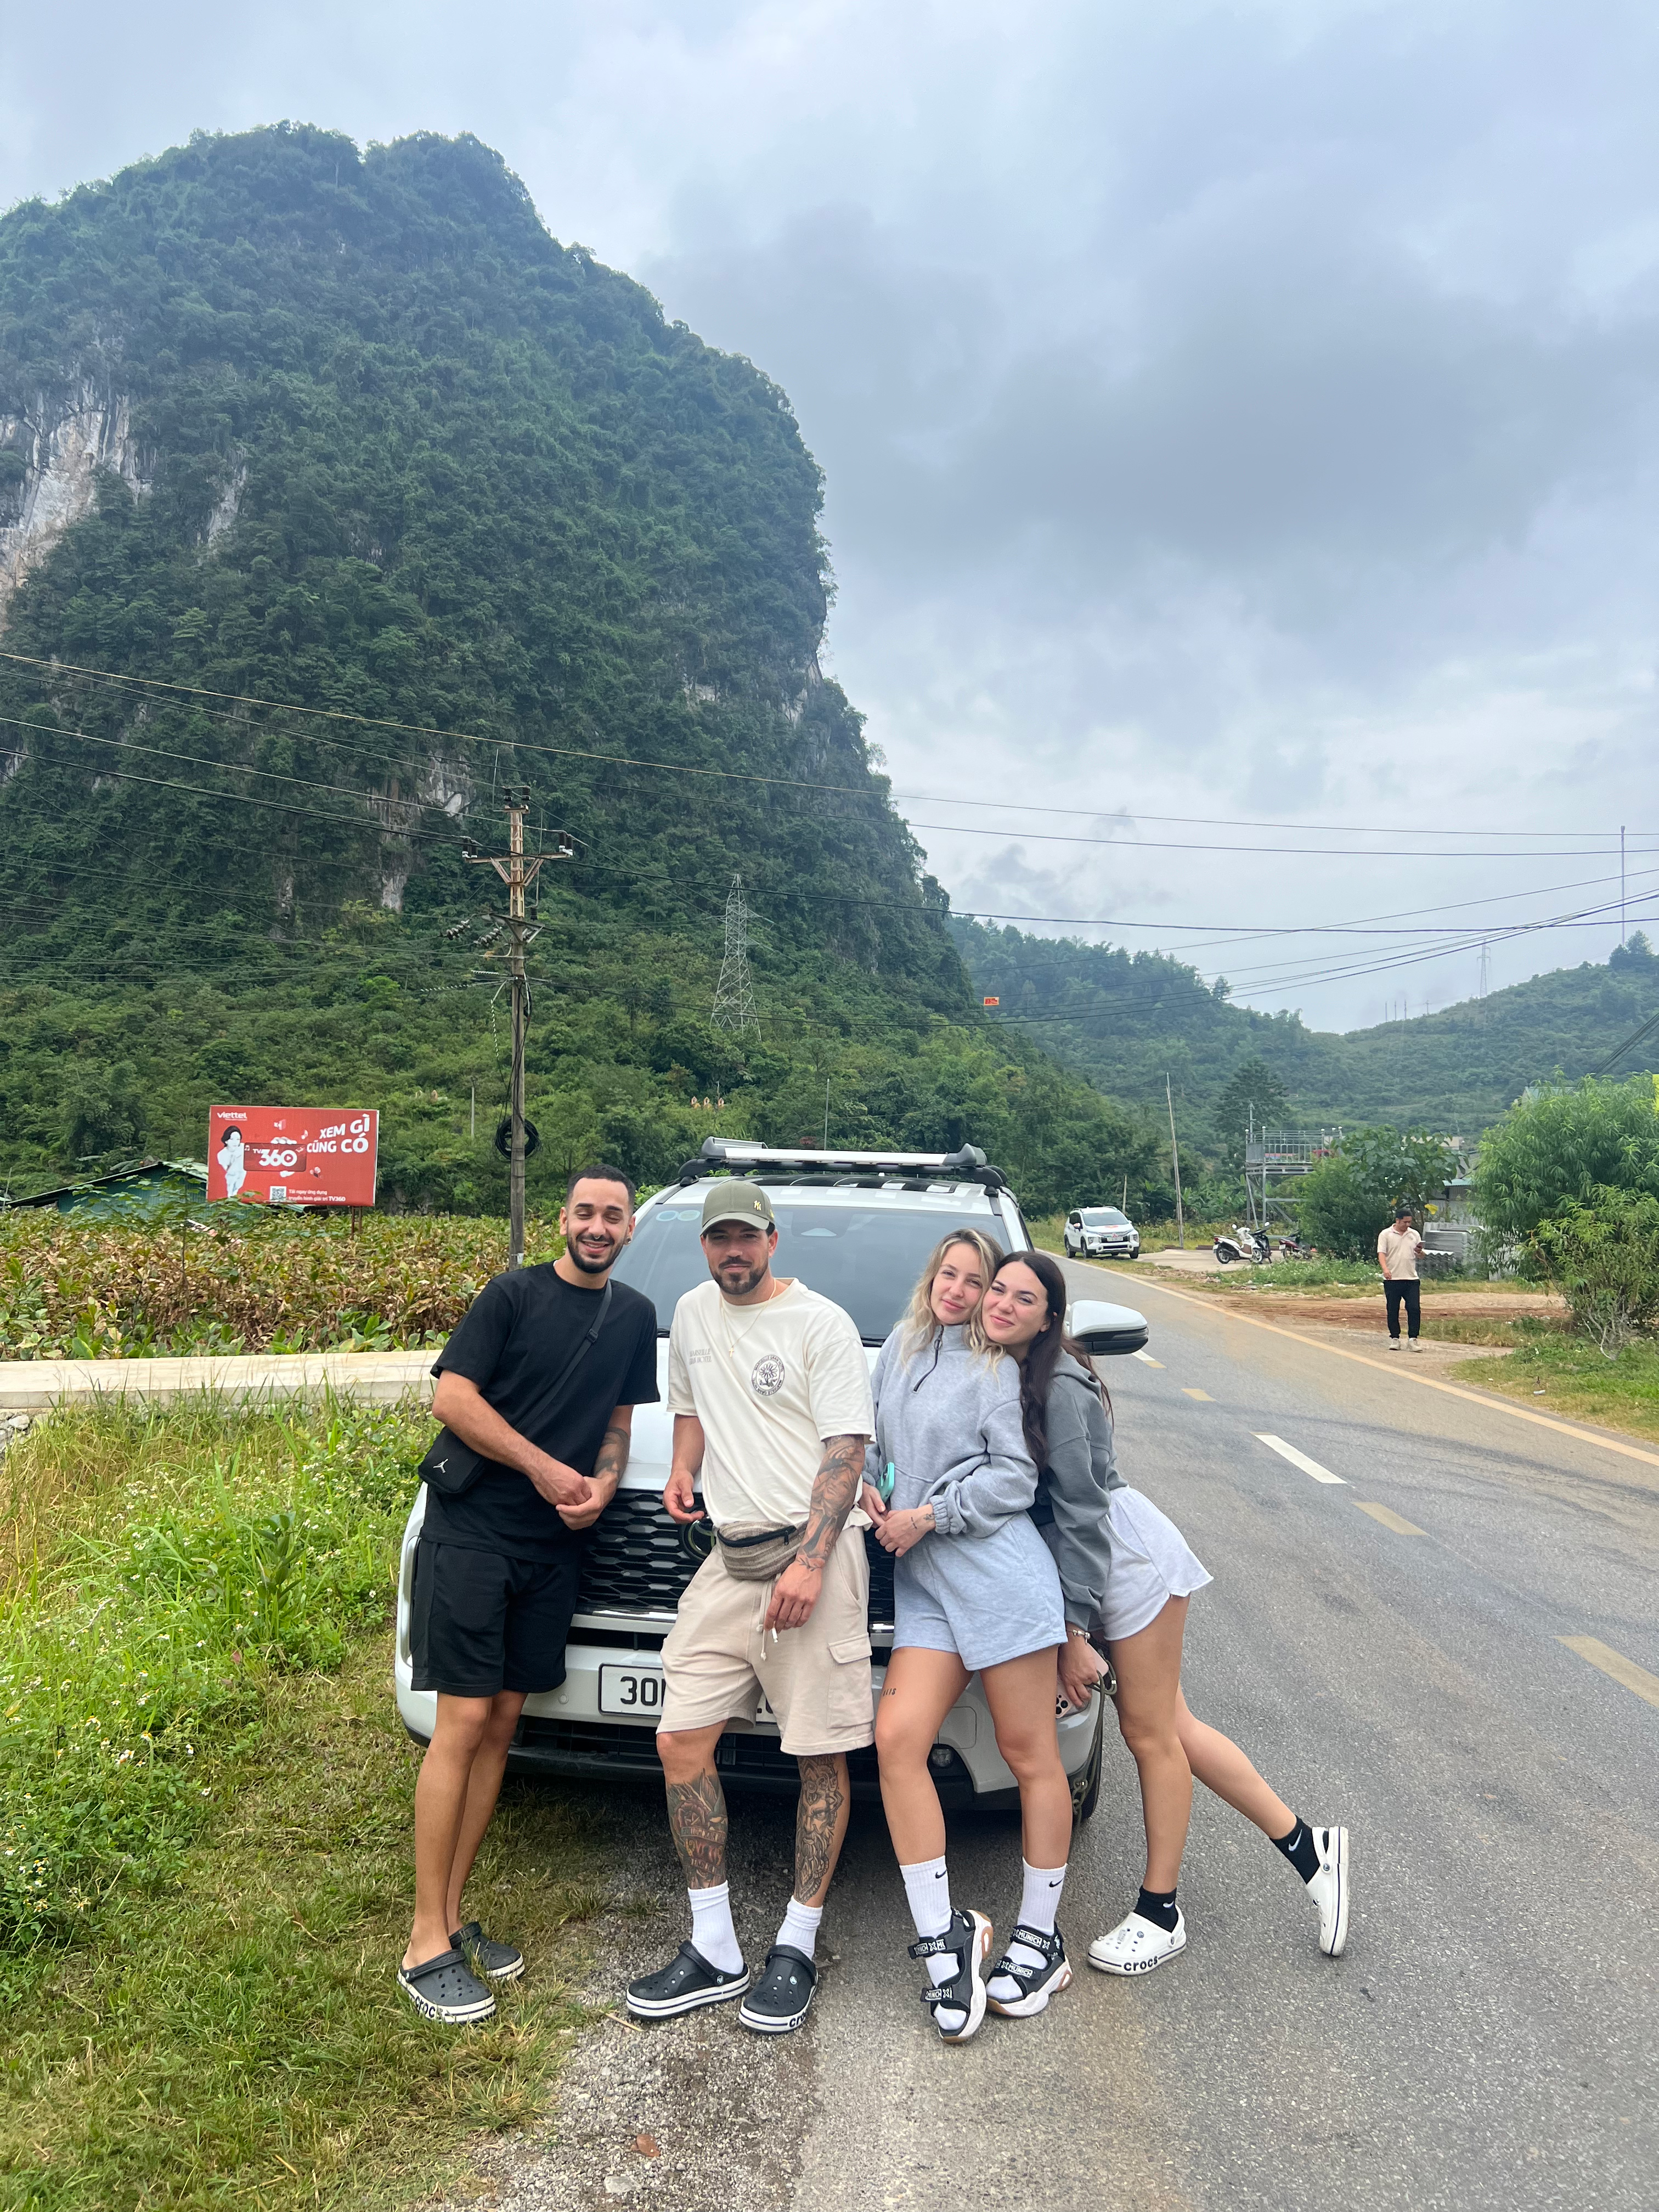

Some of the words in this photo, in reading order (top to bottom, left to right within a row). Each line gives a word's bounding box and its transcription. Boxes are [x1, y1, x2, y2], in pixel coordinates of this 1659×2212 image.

[319, 1124, 346, 1139] XEM
[350, 1114, 370, 1133] GÌ
[307, 1139, 337, 1153] CŨNG
[341, 1132, 369, 1153] CÓ
[620, 1676, 665, 1707] 30
[1018, 1930, 1042, 1946] MUNICH
[1008, 1963, 1032, 1977] MUNICH
[1124, 1956, 1158, 1971] crocs
